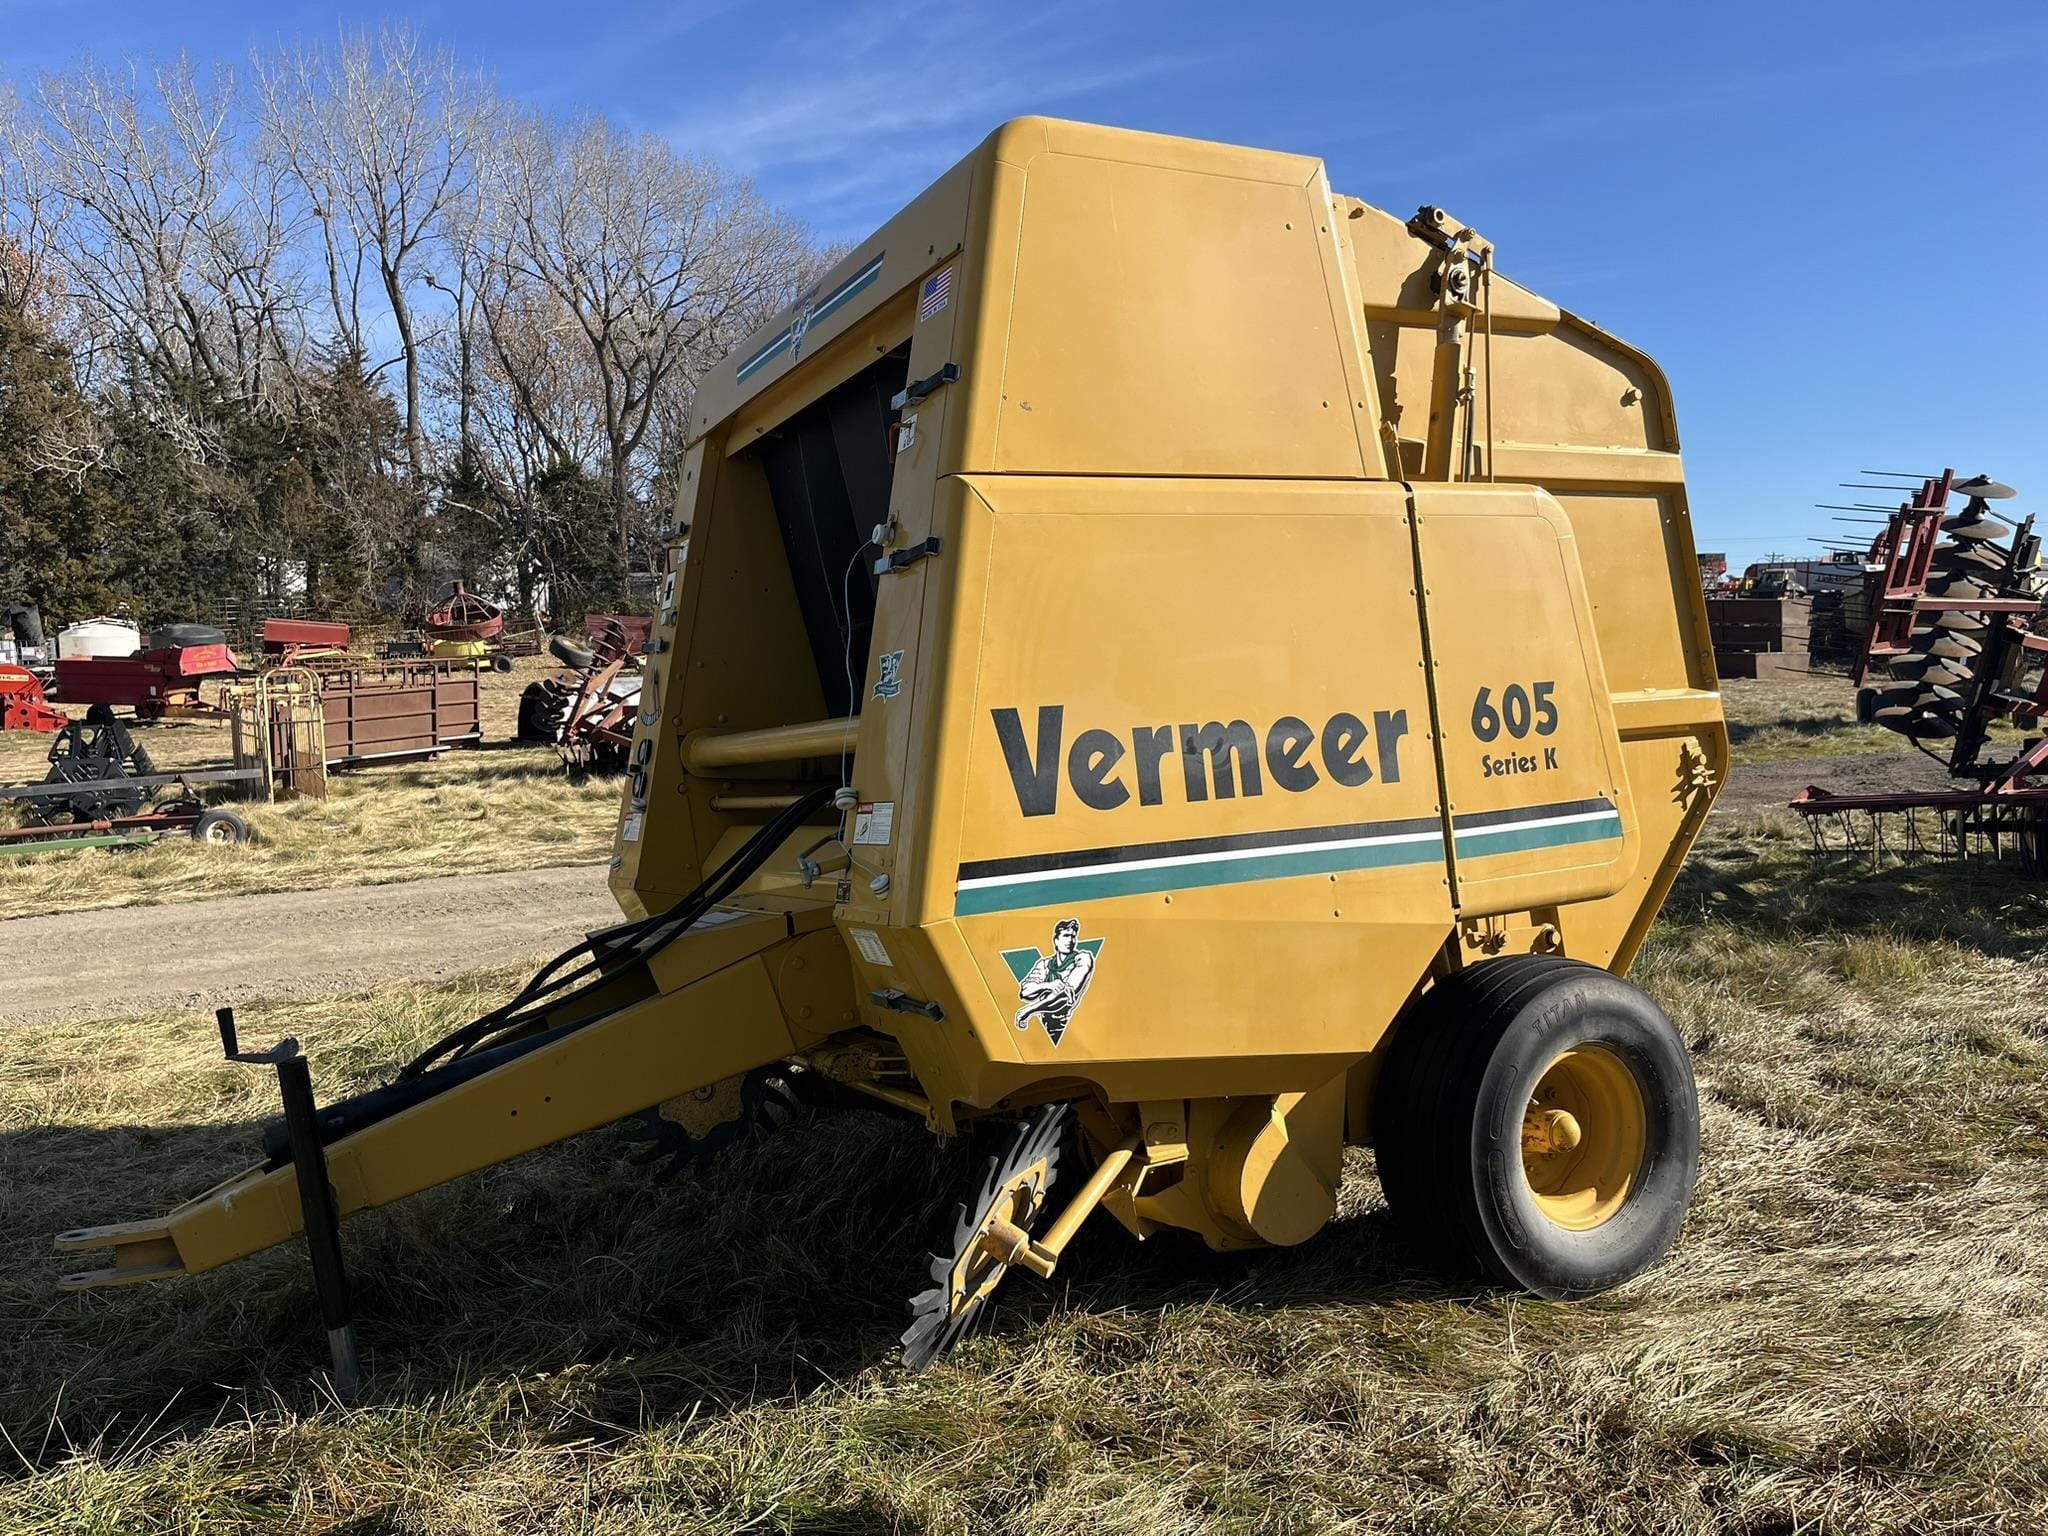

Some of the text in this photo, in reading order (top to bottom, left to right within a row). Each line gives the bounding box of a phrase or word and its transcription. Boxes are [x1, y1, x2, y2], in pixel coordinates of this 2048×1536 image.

[1471, 681, 1558, 743] 605
[990, 705, 1409, 818] Vermeer
[1482, 747, 1559, 778] Series K
[1531, 991, 1588, 1039] TITAN
